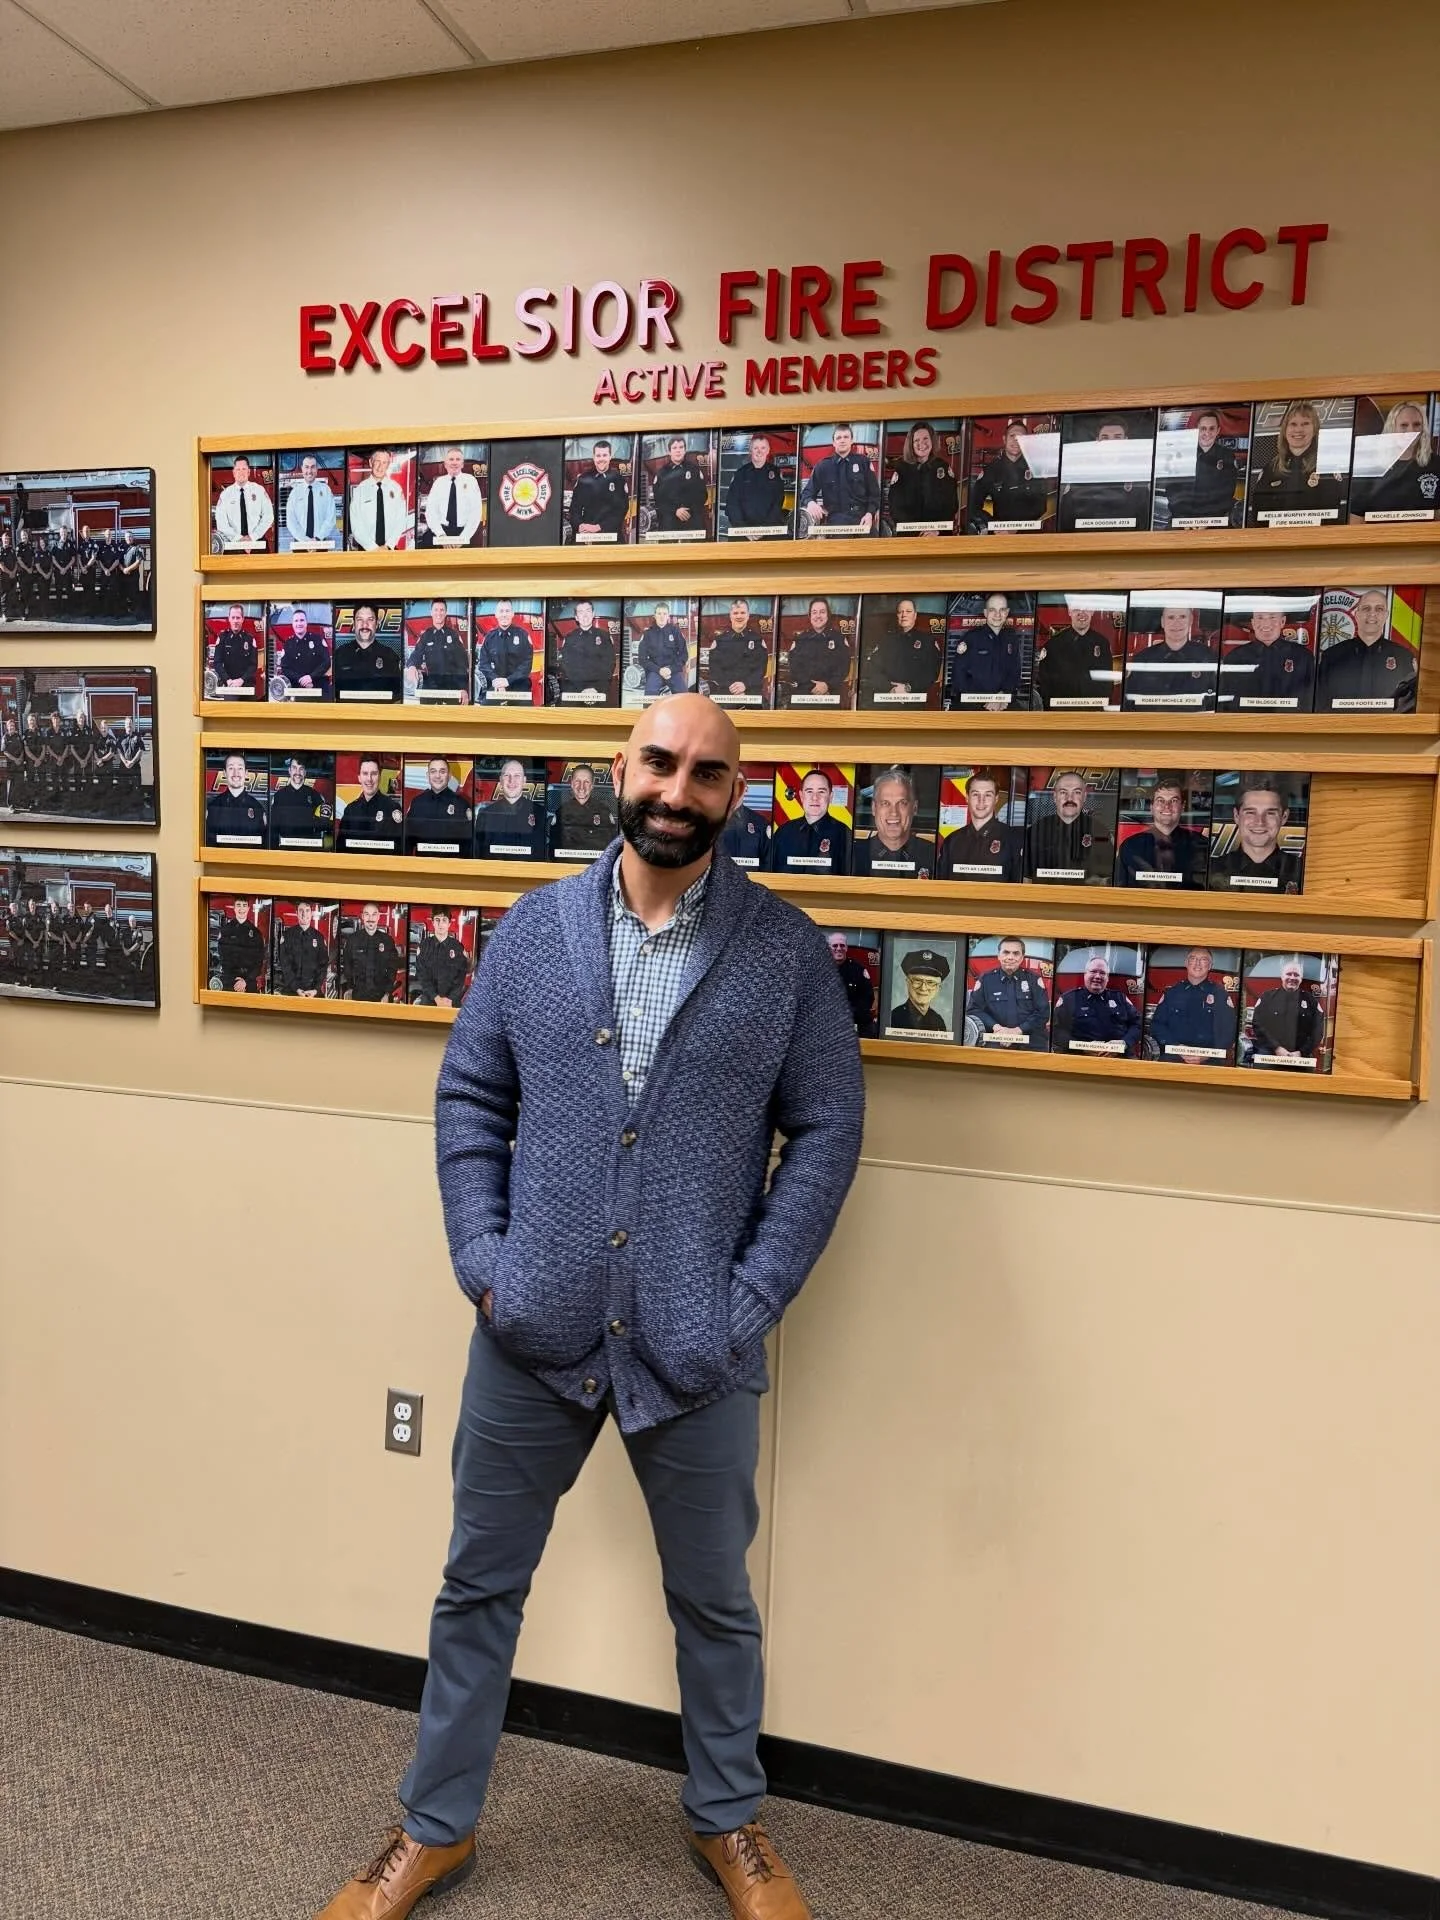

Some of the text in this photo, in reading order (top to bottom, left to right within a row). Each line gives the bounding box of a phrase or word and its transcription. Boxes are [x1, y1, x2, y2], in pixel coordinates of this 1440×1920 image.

[299, 223, 1329, 372] EXCELSIOR FIRE DISTRICT
[592, 347, 940, 405] ACTIVE MEMBERS
